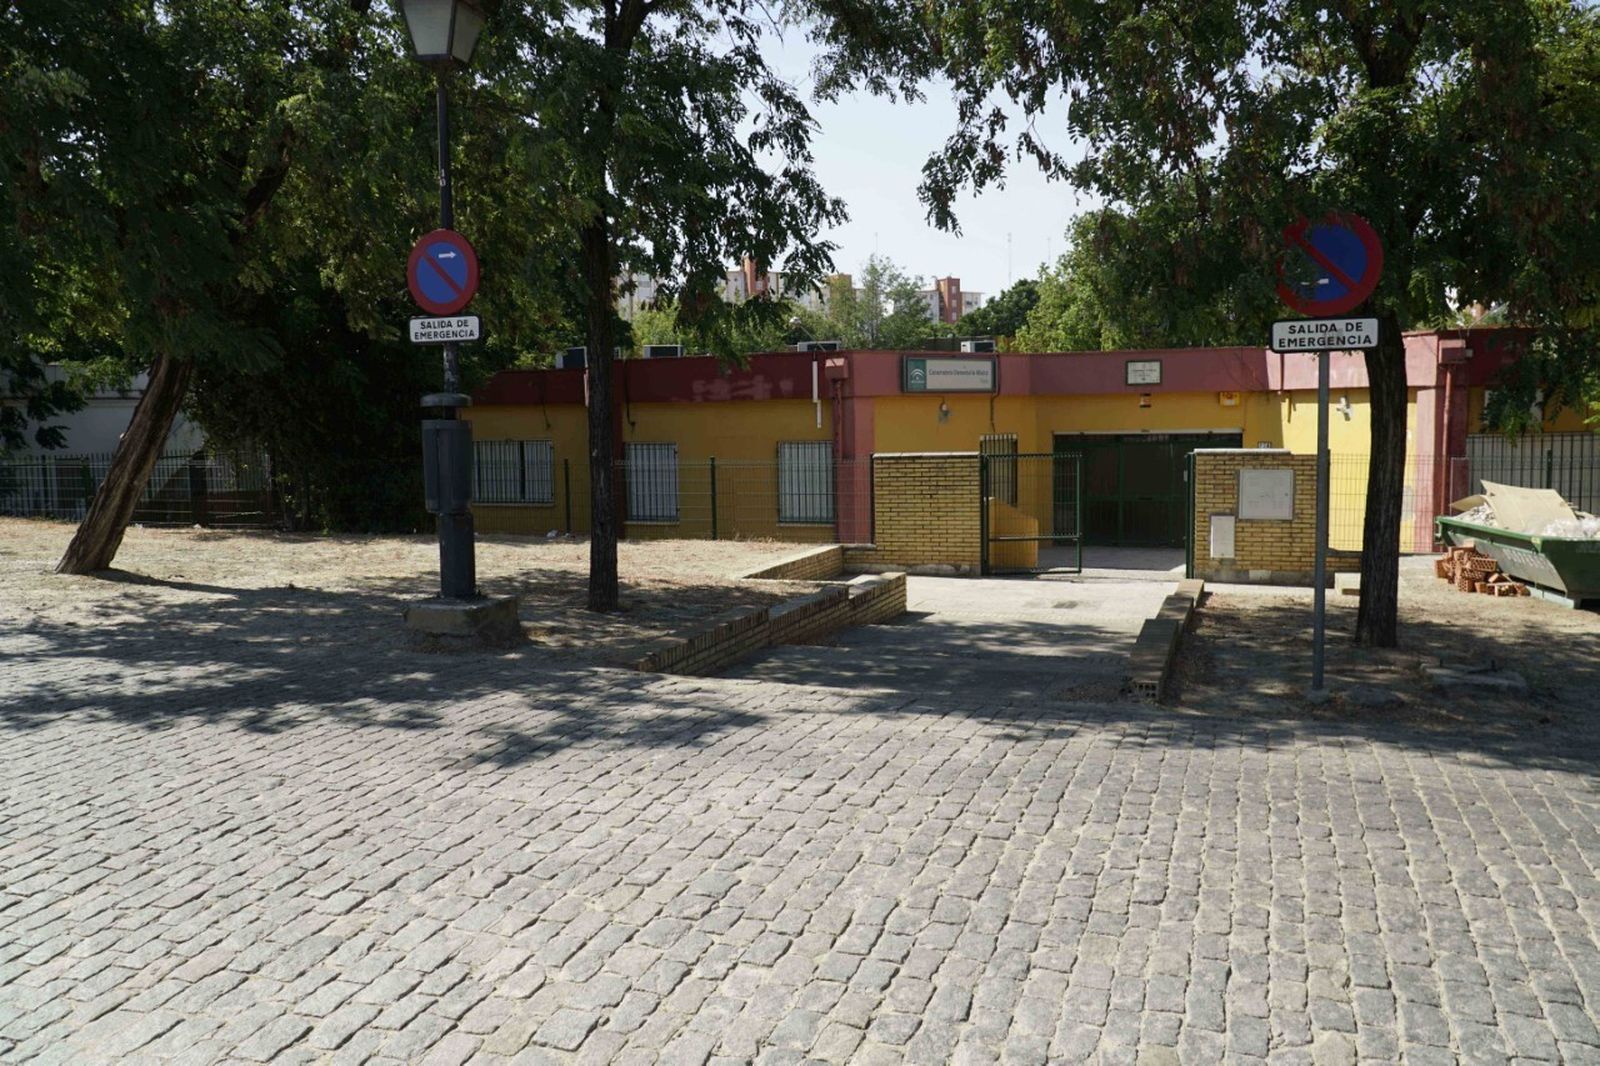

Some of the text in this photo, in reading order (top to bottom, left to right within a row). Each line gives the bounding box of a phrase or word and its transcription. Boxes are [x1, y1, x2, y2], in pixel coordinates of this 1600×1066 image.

[420, 319, 469, 330] SALIDA DE
[1288, 322, 1363, 334] SALIDA DE
[414, 329, 475, 340] EMERGENCIA
[1278, 335, 1372, 348] EMERGENCIA
